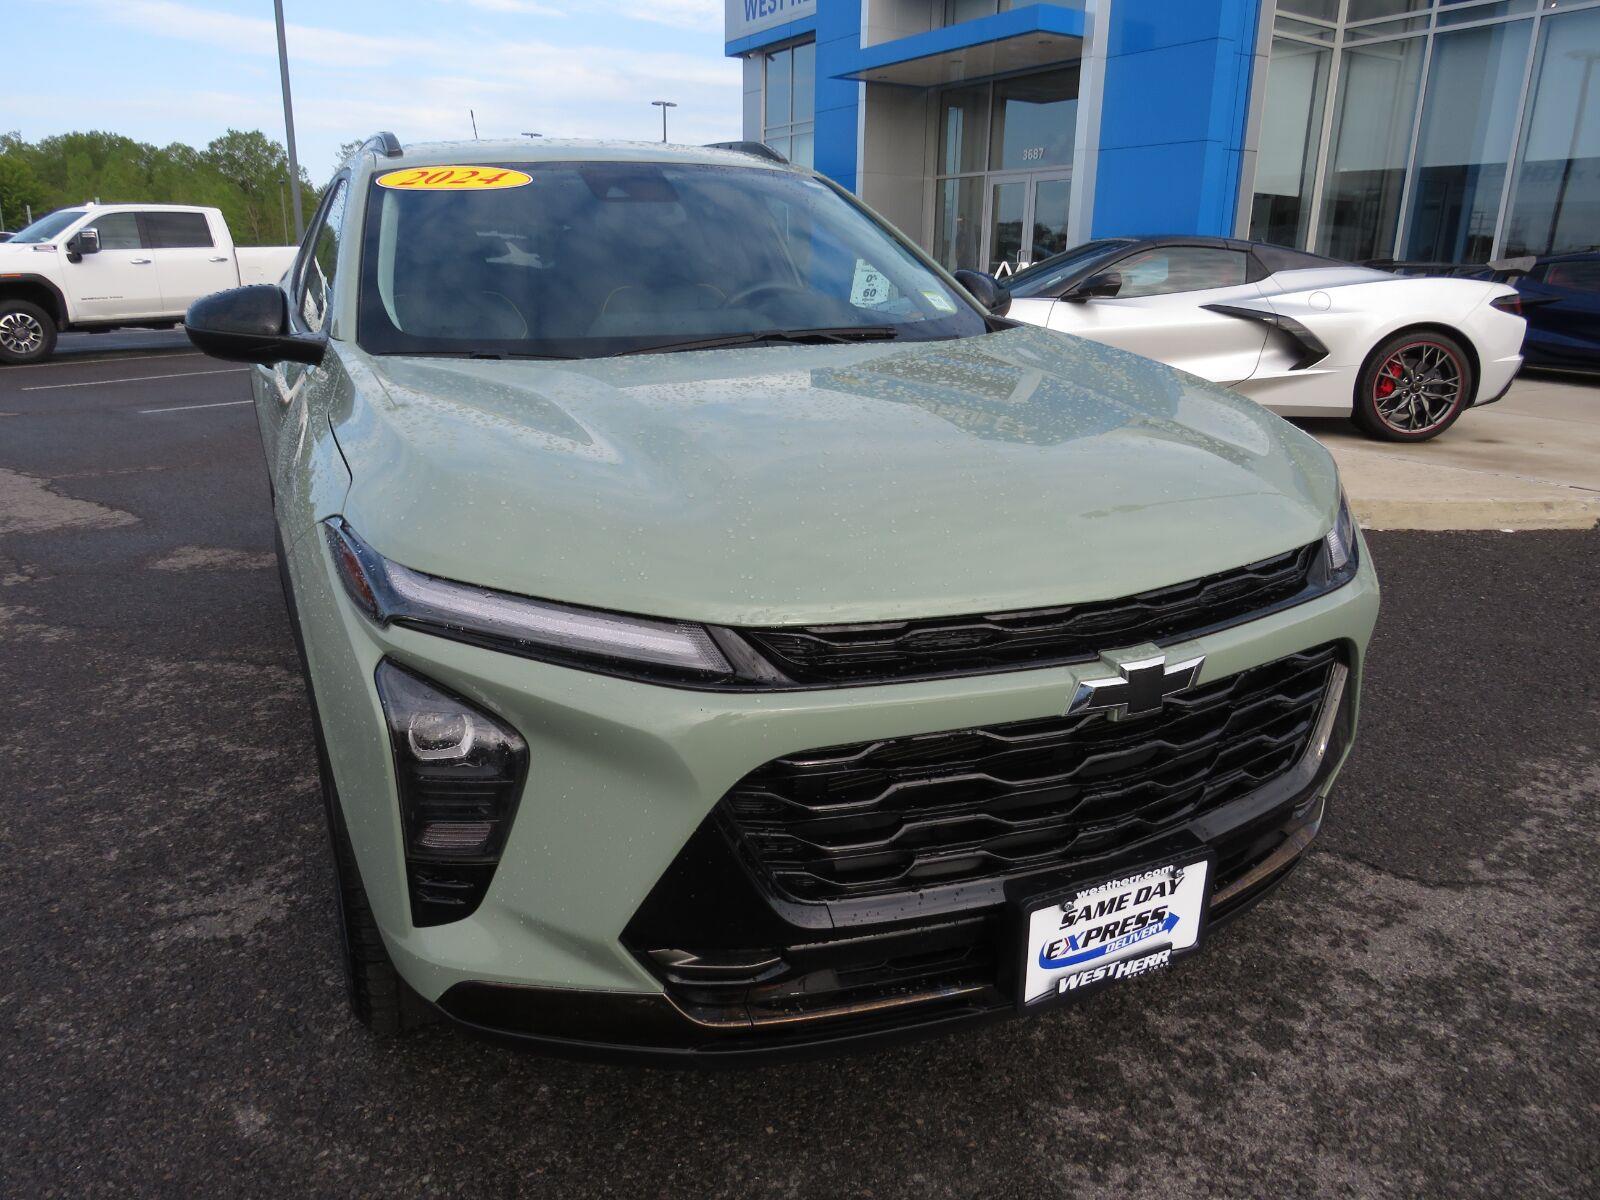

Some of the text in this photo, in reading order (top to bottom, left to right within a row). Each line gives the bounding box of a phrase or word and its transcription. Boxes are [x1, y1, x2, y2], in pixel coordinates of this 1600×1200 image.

[1022, 147, 1044, 161] 3687
[397, 170, 511, 186] 2024
[863, 288, 877, 297] 60
[1076, 865, 1174, 900] westherr.com
[1059, 877, 1184, 930] SAME DAY
[1046, 905, 1168, 959] EXPRESS
[1105, 920, 1166, 955] DELIVERY
